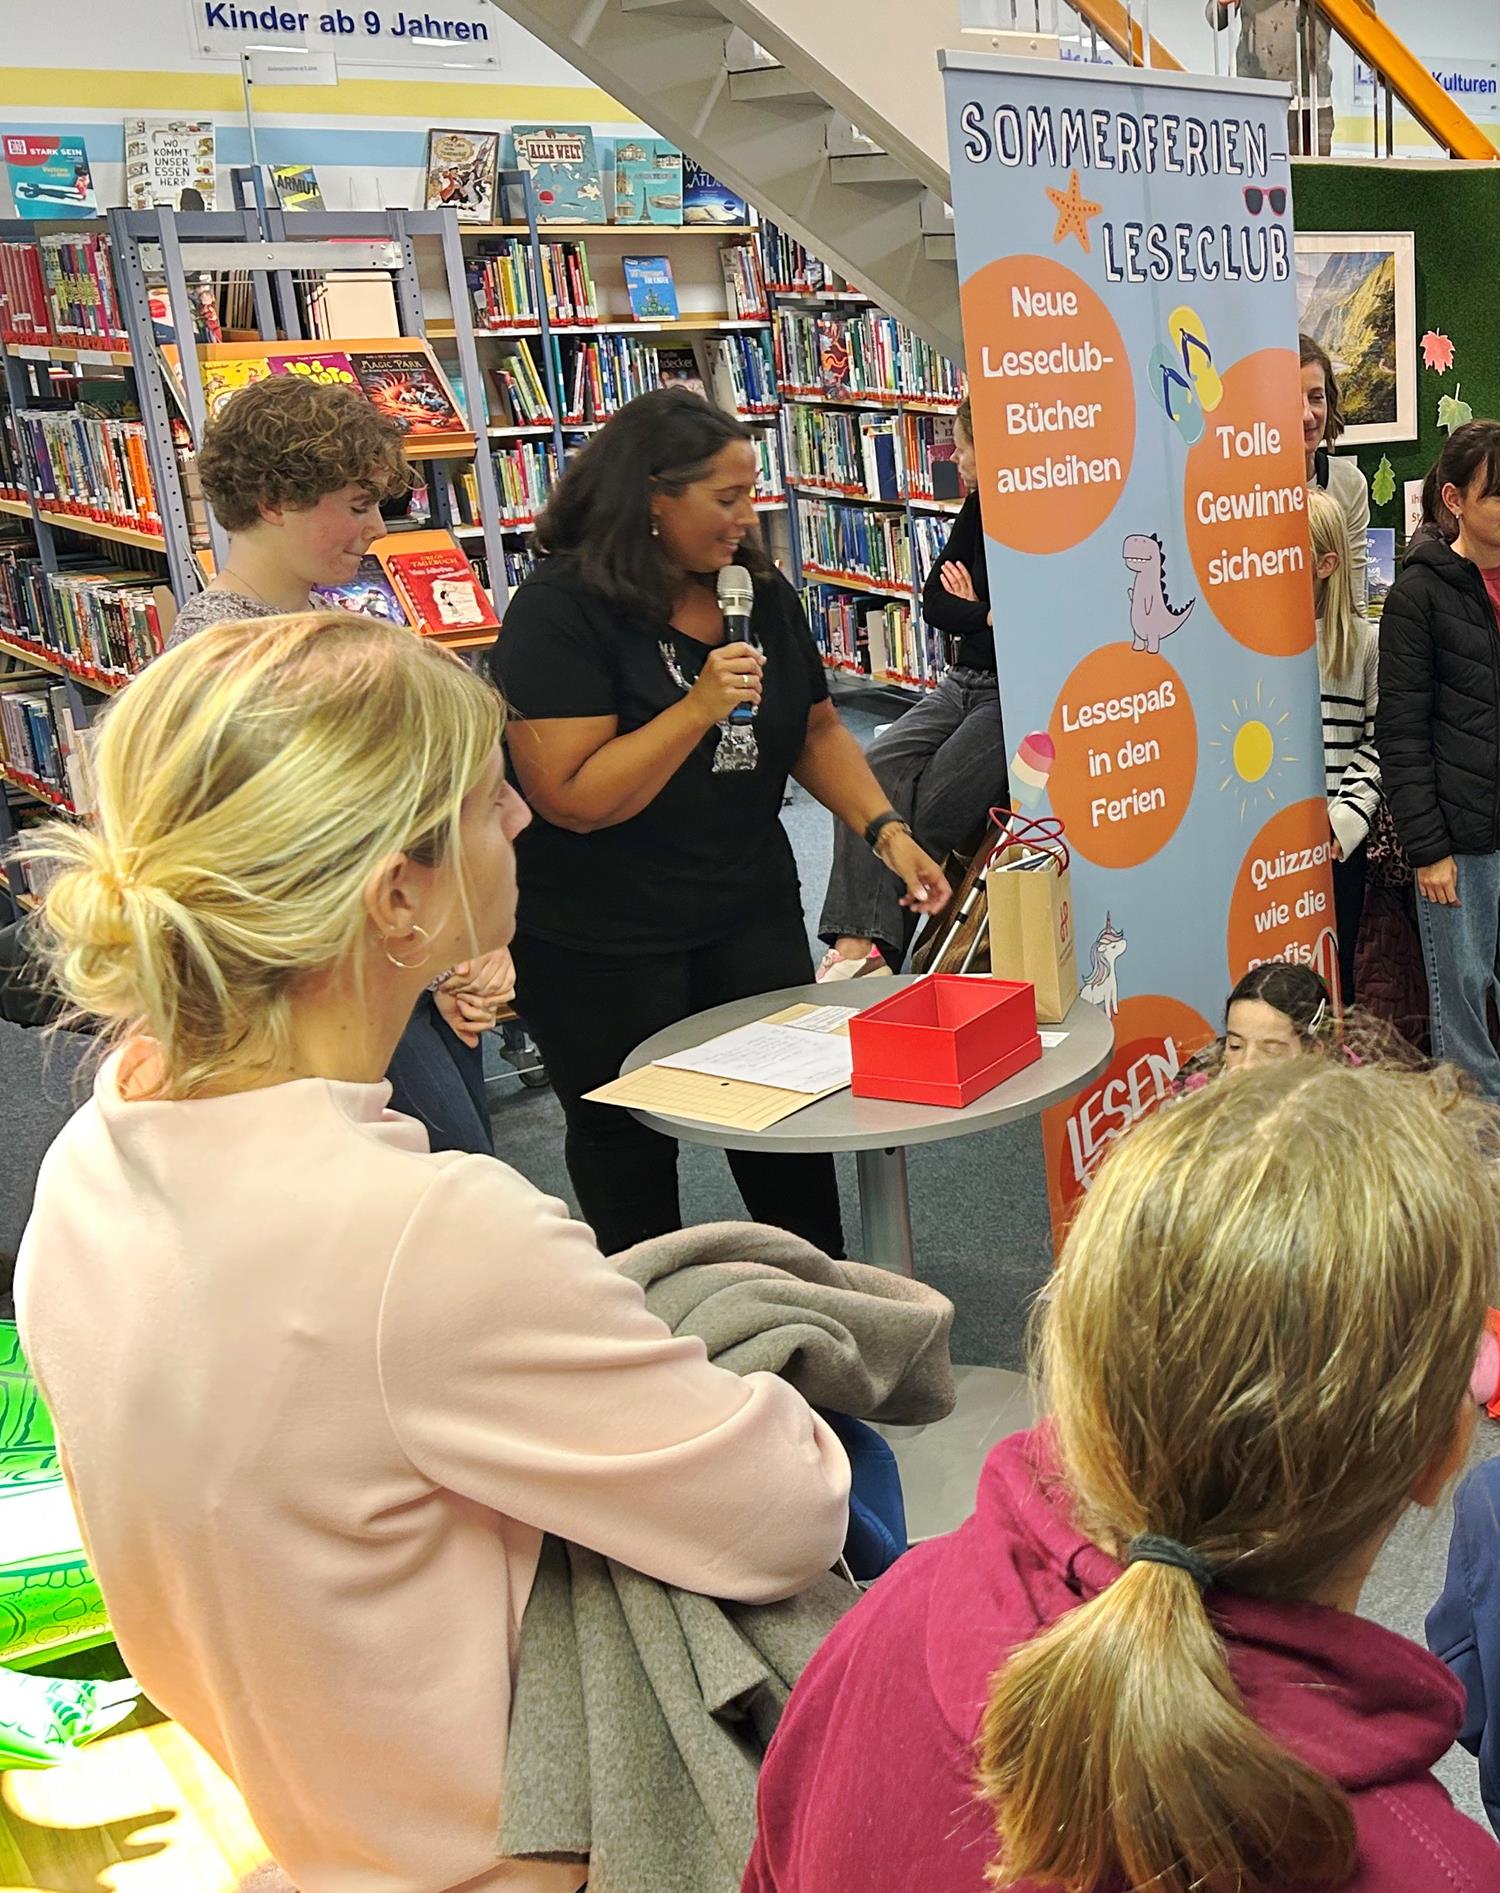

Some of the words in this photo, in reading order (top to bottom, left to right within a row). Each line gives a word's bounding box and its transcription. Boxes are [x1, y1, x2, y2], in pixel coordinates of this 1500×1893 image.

[204, 2, 310, 32] Kinder
[320, 9, 356, 34] ab
[364, 10, 381, 36] 9
[391, 12, 489, 41] Jahren
[30, 148, 58, 156] STARK
[153, 148, 189, 157] KOMMT
[163, 139, 178, 148] WO
[529, 143, 554, 159] ALLE
[555, 143, 583, 159] WELT
[960, 101, 1289, 178] SOMMERFERIEN-
[154, 157, 189, 166] UNSER
[154, 167, 190, 177] ESSEN
[687, 173, 722, 188] ATLA
[160, 177, 186, 186] HER?
[276, 174, 318, 196] ARMUT
[1102, 223, 1291, 284] LESECLUB
[1011, 286, 1078, 318] Neue
[361, 359, 394, 370] MAGIC
[395, 359, 424, 370] PARK
[980, 342, 1114, 378] Leseclub-
[1005, 399, 1102, 436] Bücher
[1216, 421, 1281, 460] Tolle
[996, 455, 1122, 494] ausleihen
[1196, 483, 1305, 525] Gewinne
[1207, 546, 1304, 585] sichern
[1061, 680, 1177, 733] Lesespaß
[1087, 748, 1112, 778] in
[1117, 738, 1160, 768] den
[1091, 786, 1167, 828] Ferien
[1250, 841, 1331, 892] Quizzen
[1254, 901, 1290, 934] wie
[1295, 889, 1327, 919] die
[1066, 1036, 1181, 1181] LESEN
